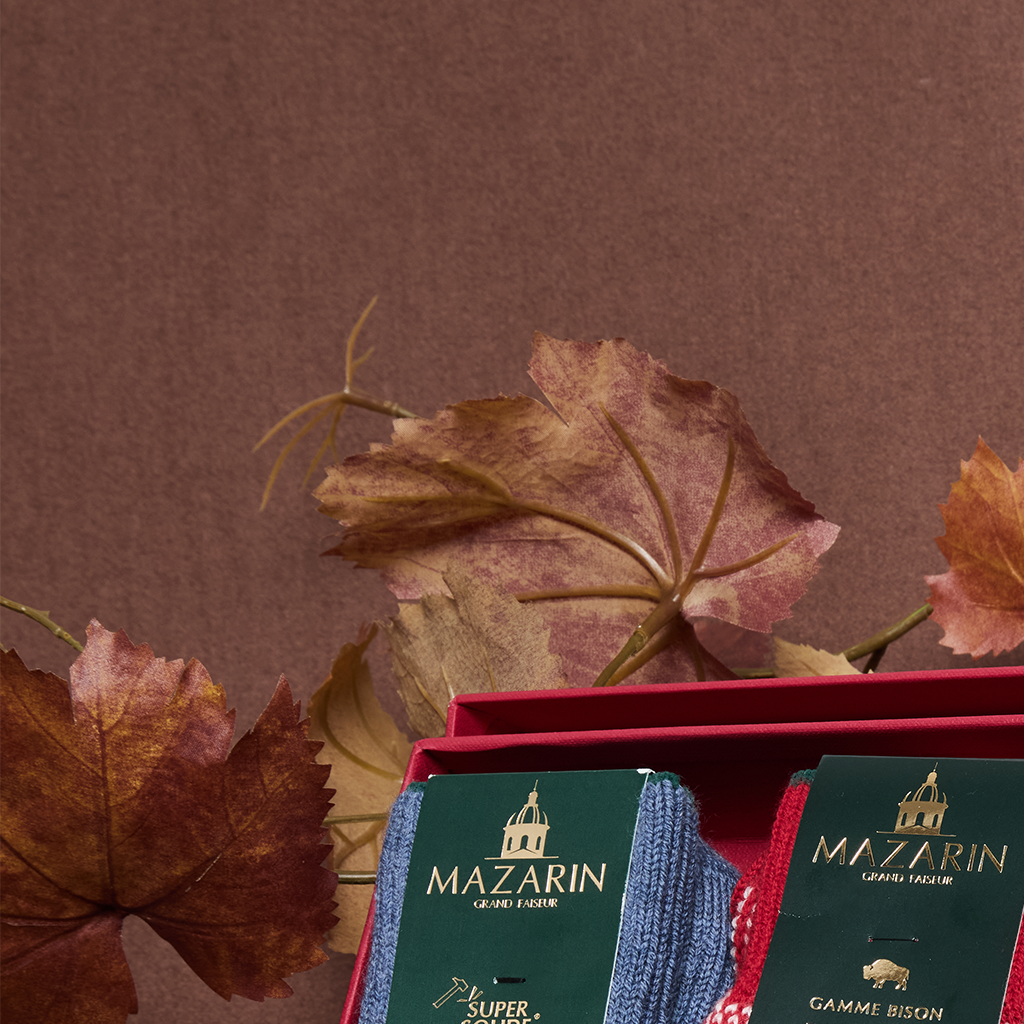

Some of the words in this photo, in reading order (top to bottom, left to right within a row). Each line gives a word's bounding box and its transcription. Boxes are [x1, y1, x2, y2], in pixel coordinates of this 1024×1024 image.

[812, 835, 1008, 873] MAZARIN
[426, 863, 606, 895] MAZARIN
[862, 871, 904, 883] GRAND
[909, 874, 953, 885] FAISEUR
[474, 898, 513, 909] GRAND
[517, 898, 558, 908] FAISEUR
[467, 1001, 528, 1018] SUPER
[809, 996, 880, 1016] GAMME
[887, 1004, 944, 1021] BISON
